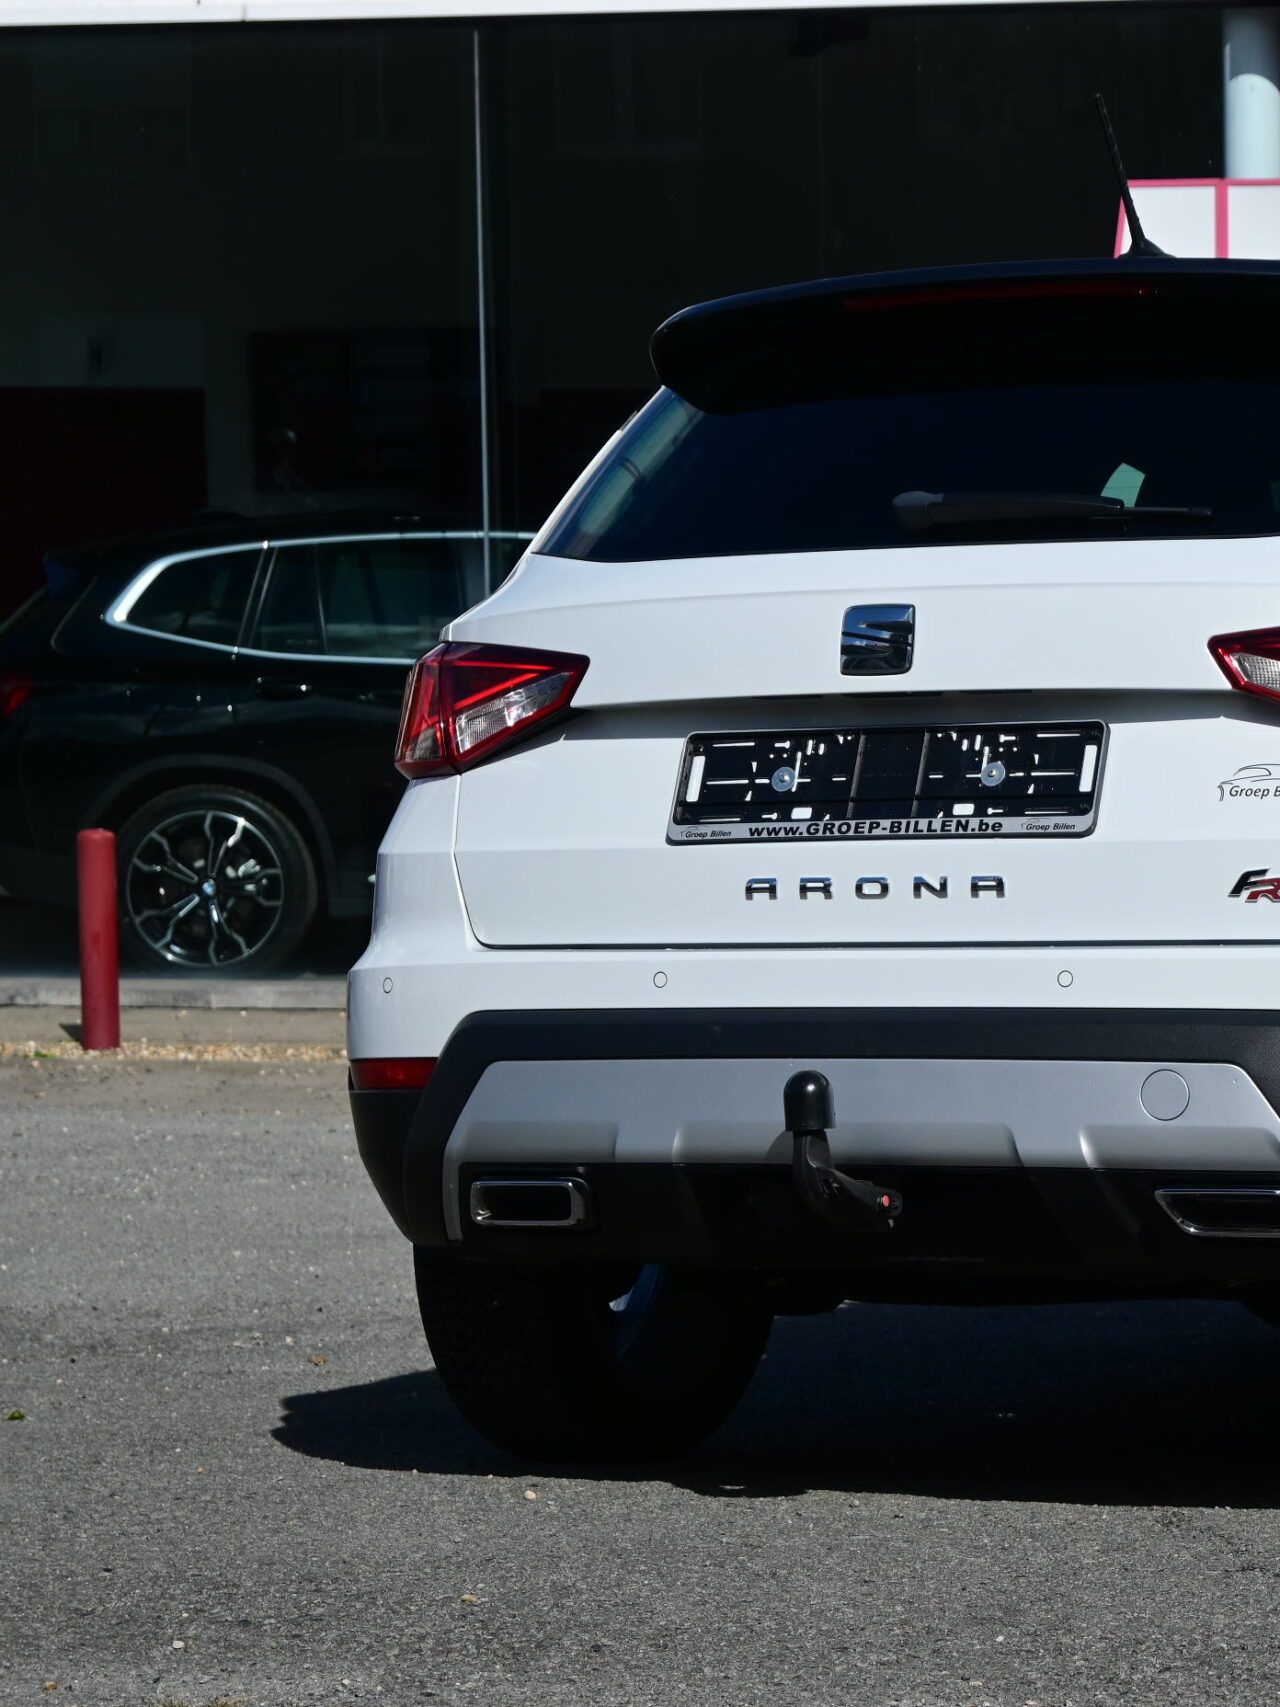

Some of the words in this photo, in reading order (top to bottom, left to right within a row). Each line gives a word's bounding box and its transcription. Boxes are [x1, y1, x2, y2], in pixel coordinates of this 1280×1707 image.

[1229, 785, 1270, 799] Groep
[748, 819, 1004, 837] www.GROEP-BILLEN.be
[1025, 823, 1050, 832] Groep
[1053, 822, 1076, 831] Billen
[685, 830, 708, 839] Groep
[710, 830, 732, 838] Billen
[744, 875, 1007, 901] ARONA
